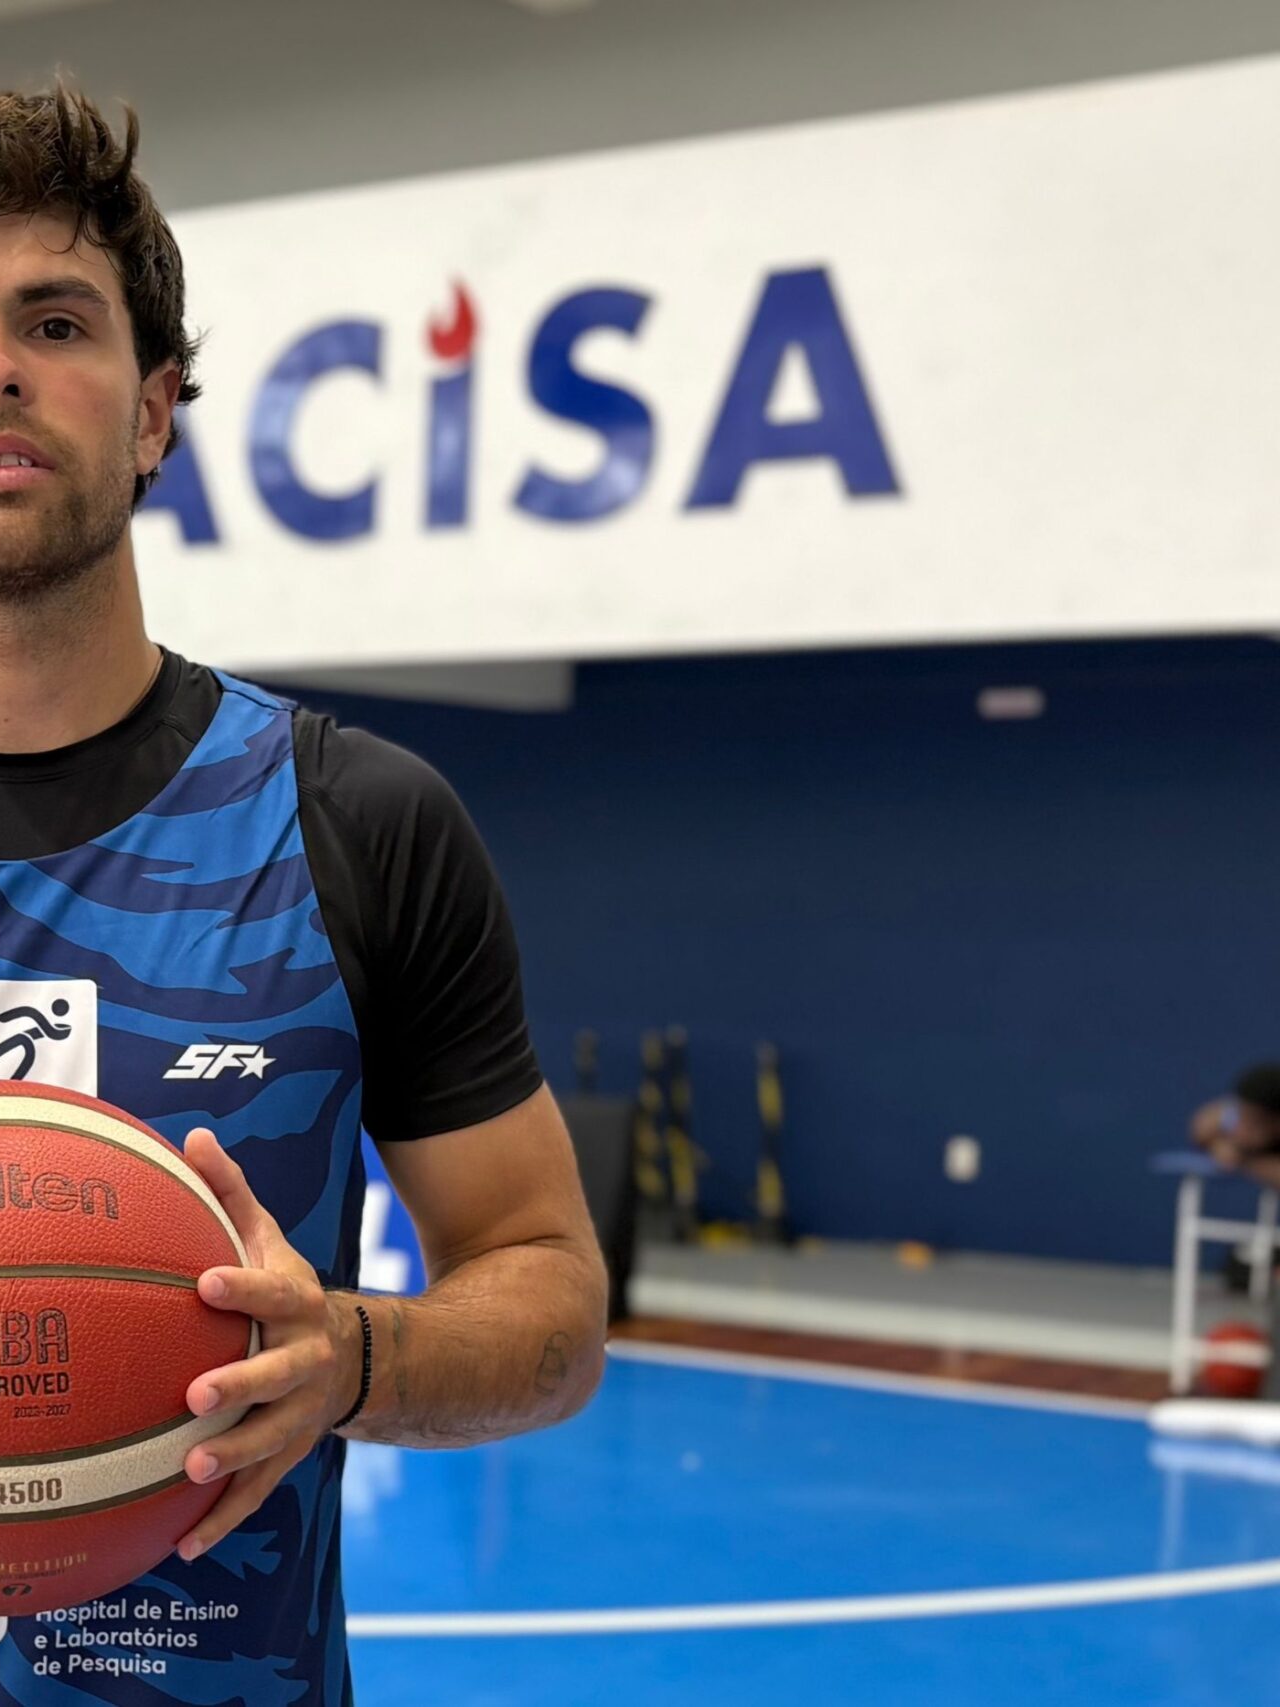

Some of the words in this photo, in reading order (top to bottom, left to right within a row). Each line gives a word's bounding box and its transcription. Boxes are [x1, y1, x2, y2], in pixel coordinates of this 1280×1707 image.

[134, 1599, 162, 1620] de
[170, 1601, 239, 1621] Ensino
[34, 1634, 48, 1648] e
[55, 1627, 198, 1648] Laboratórios
[33, 1655, 61, 1675] de
[68, 1653, 167, 1677] Pesquisa
